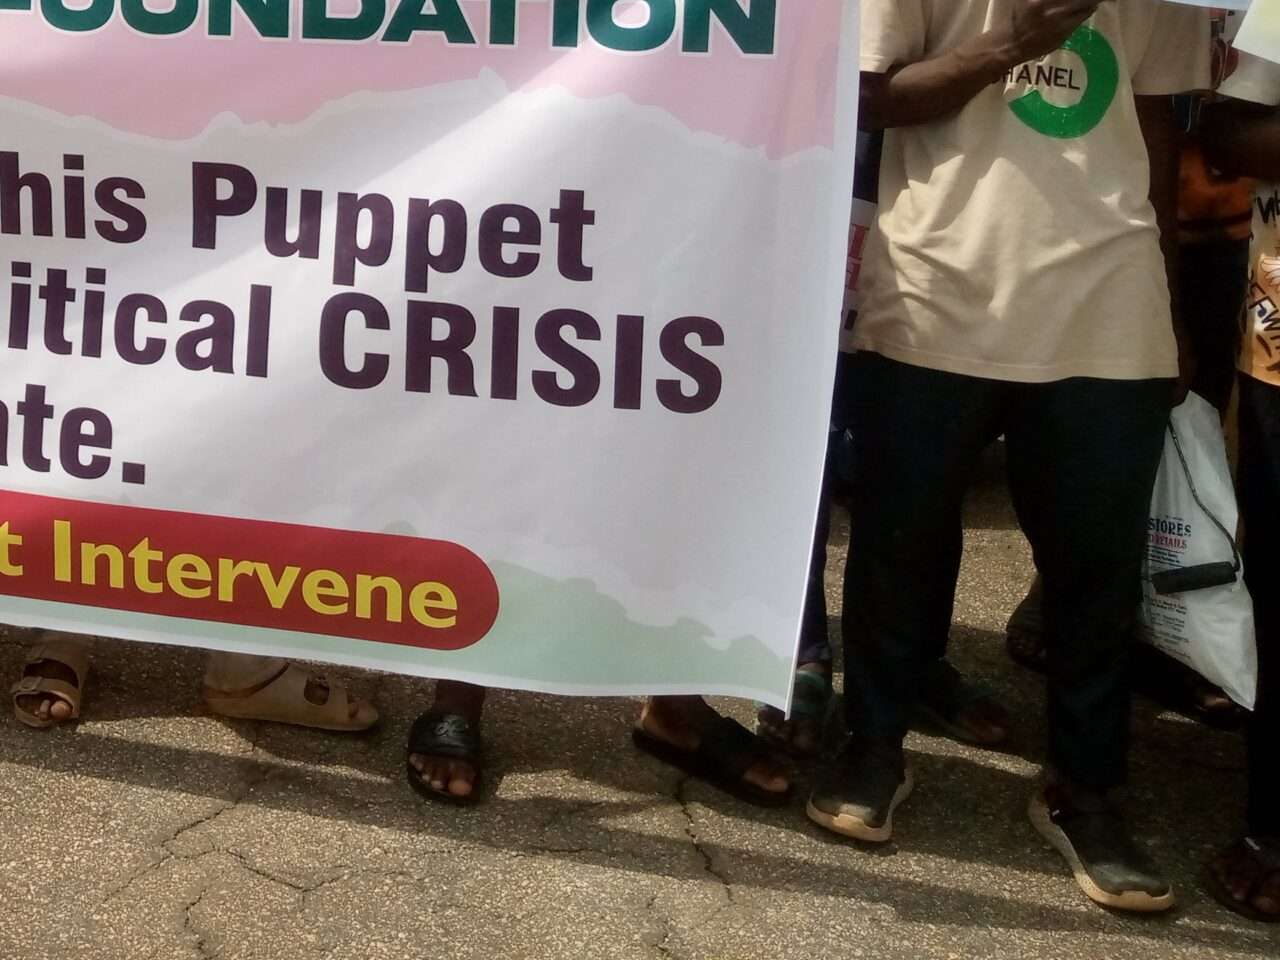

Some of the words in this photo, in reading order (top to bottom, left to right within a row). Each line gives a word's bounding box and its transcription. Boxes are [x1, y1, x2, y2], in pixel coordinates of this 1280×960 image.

[1002, 63, 1081, 90] HANEL
[0, 151, 147, 243] his
[192, 162, 595, 293] Puppet
[320, 293, 724, 414] CRISIS
[55, 521, 456, 627] Intervene
